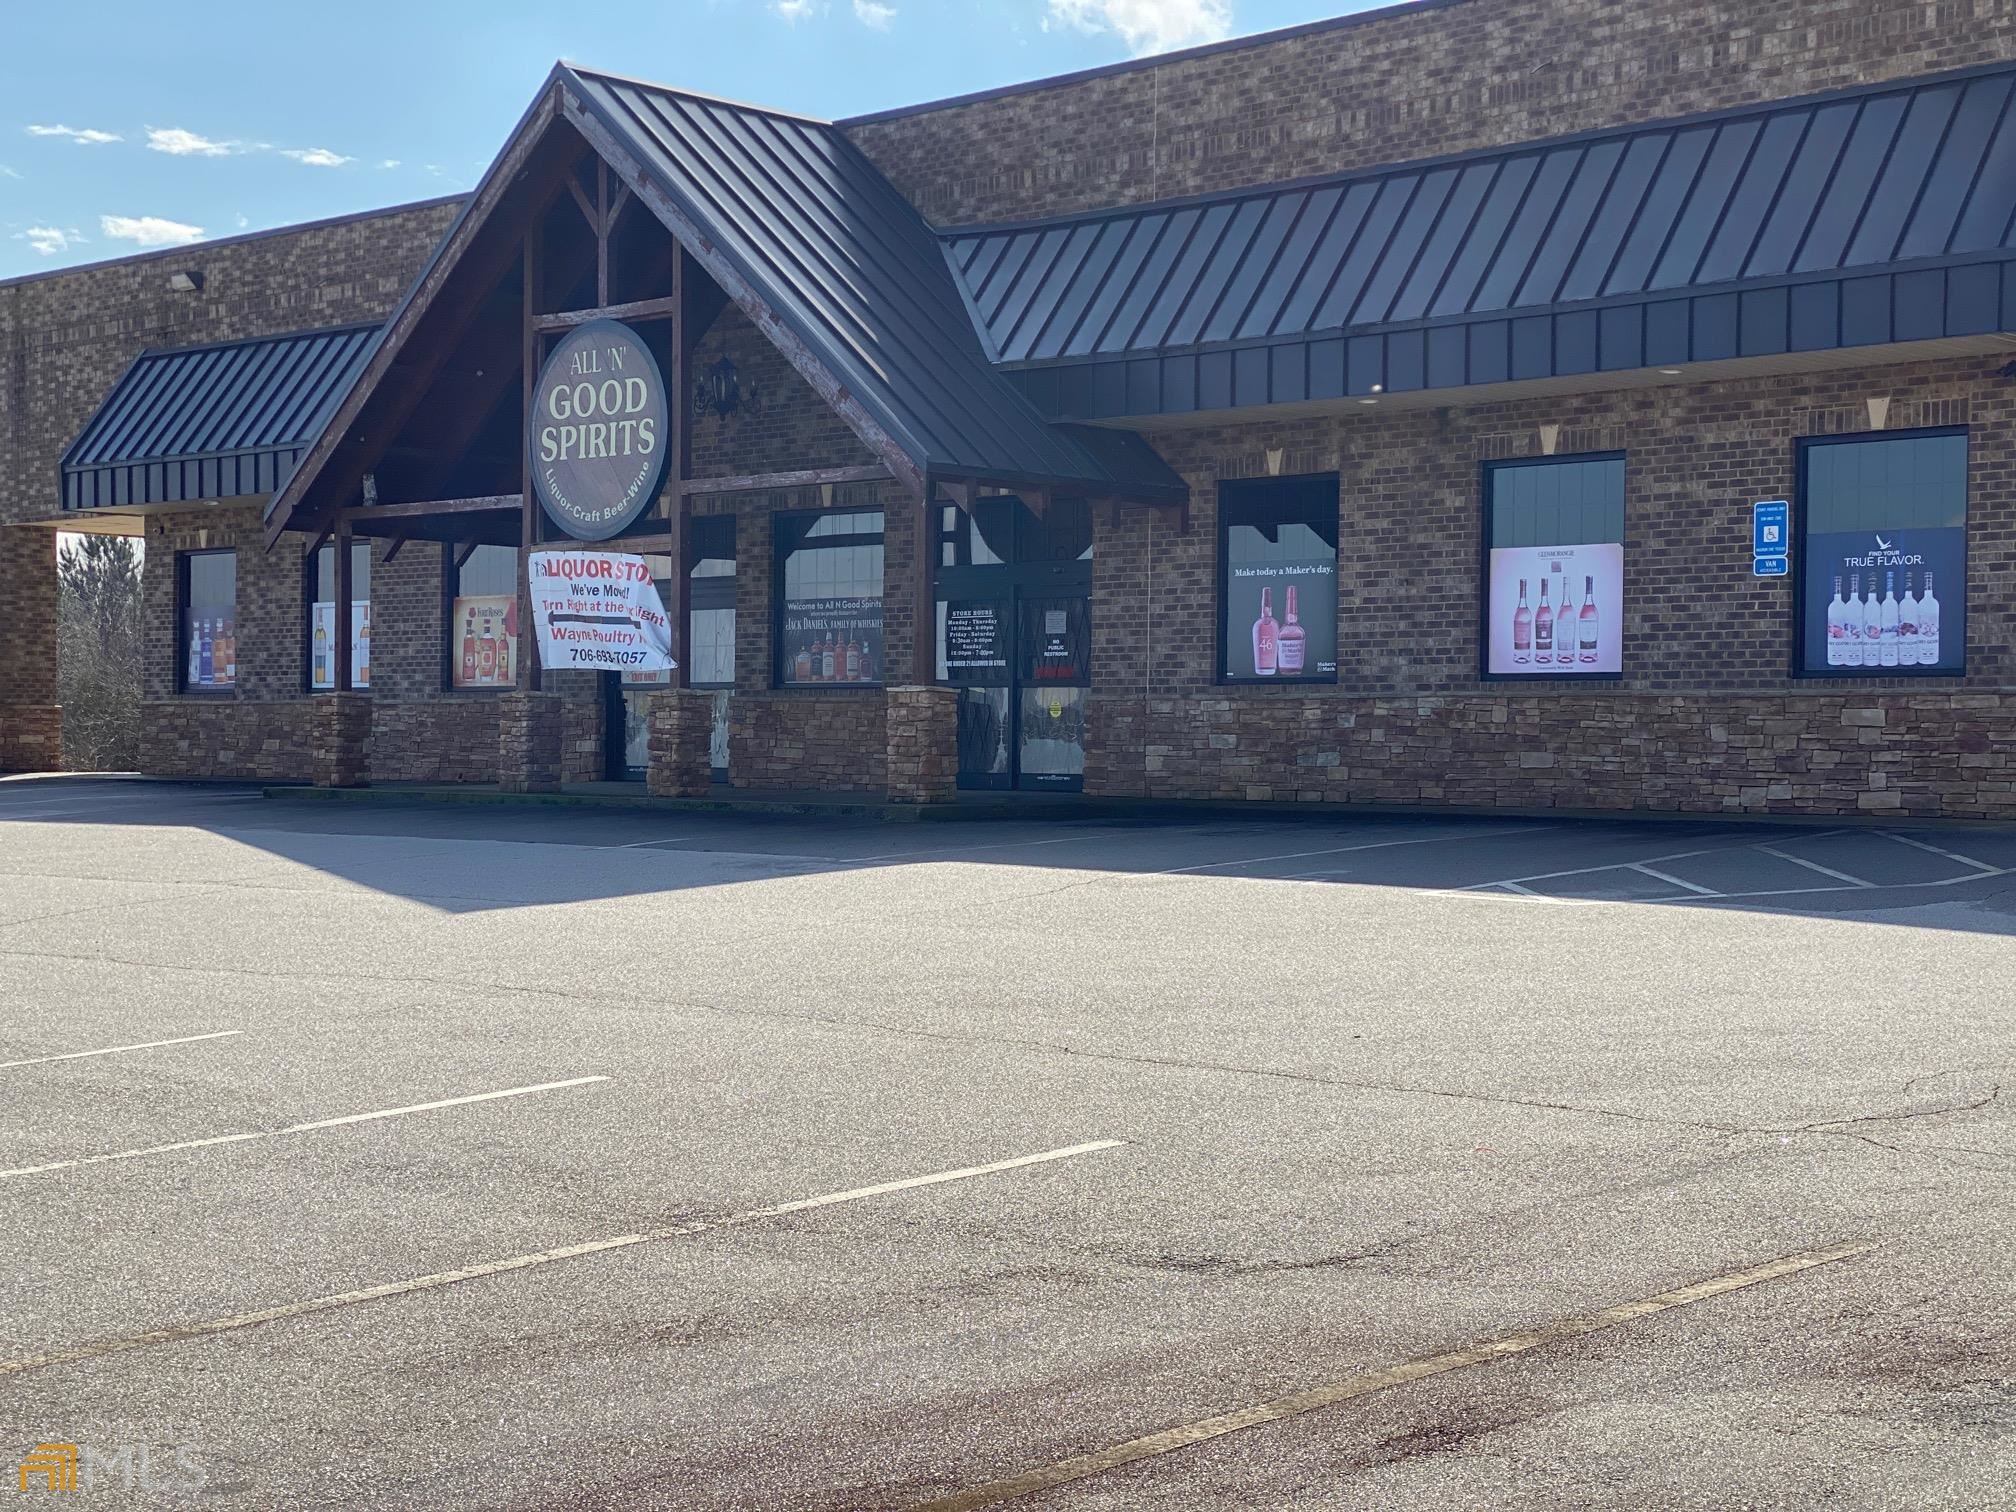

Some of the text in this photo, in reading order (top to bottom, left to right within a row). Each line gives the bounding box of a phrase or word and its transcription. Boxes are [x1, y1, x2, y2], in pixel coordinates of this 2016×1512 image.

[570, 350, 601, 375] ALL
[550, 377, 647, 420] GOOD
[540, 418, 655, 462] SPIRITS
[545, 468, 600, 522] Liquor-Craft
[1765, 560, 1776, 568] VAN
[1844, 557, 1874, 567] TRUE
[546, 559, 612, 580] LIQUOR
[1257, 568, 1276, 576] today
[1285, 566, 1316, 574] Maker's
[1317, 565, 1333, 574] day.
[571, 583, 600, 596] We've
[590, 601, 601, 612] at
[605, 600, 624, 612] the
[788, 602, 816, 610] Welcome
[842, 600, 860, 608] Good
[862, 599, 882, 610] Spirits
[551, 627, 592, 643] Wayne
[592, 629, 636, 646] Poultry
[1260, 639, 1272, 652] 46
[570, 649, 648, 664] 706-693-7057
